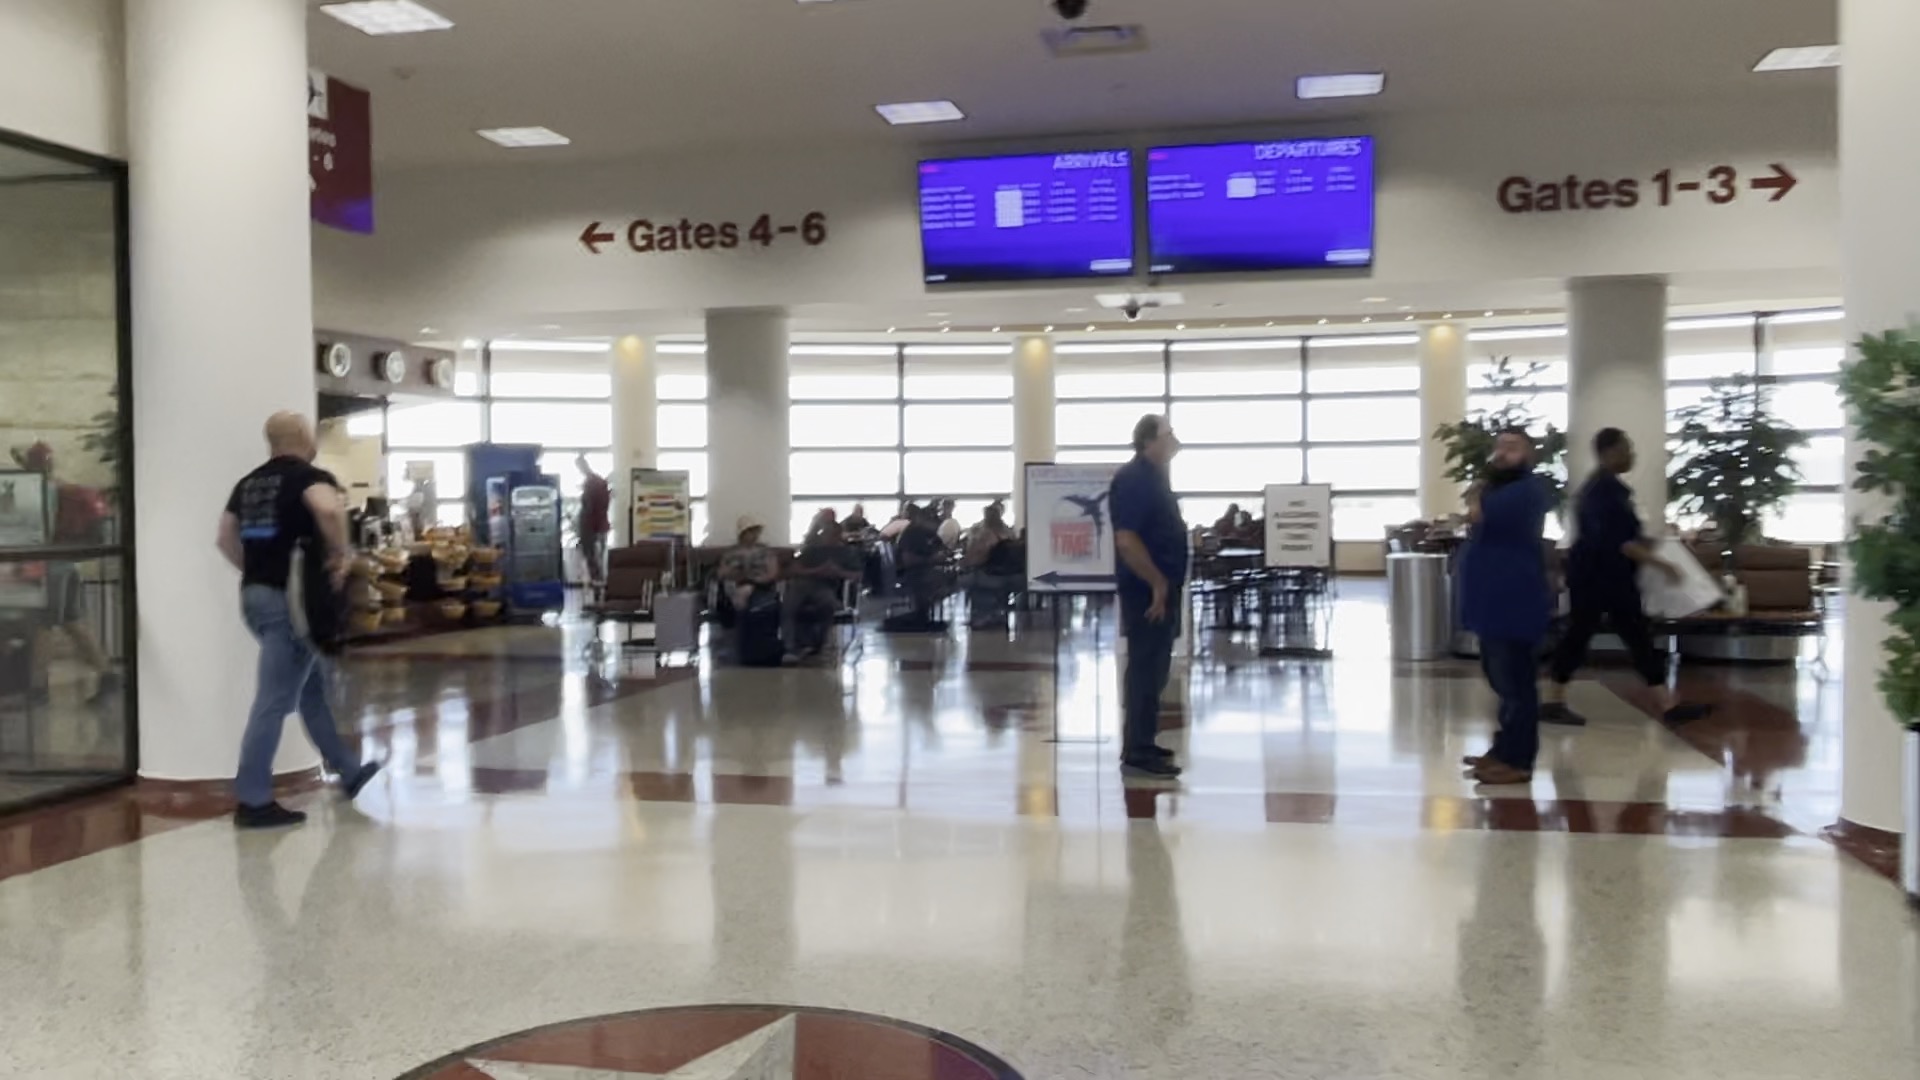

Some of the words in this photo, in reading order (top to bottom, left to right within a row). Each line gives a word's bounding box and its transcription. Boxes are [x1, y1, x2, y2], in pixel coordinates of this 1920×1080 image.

[1053, 151, 1129, 171] ARRIVALS
[1254, 139, 1362, 160] DEPARTURES
[1498, 174, 1639, 214] Gates
[1652, 165, 1738, 207] 1-3
[628, 217, 738, 253] Gates
[748, 211, 828, 248] 4-6
